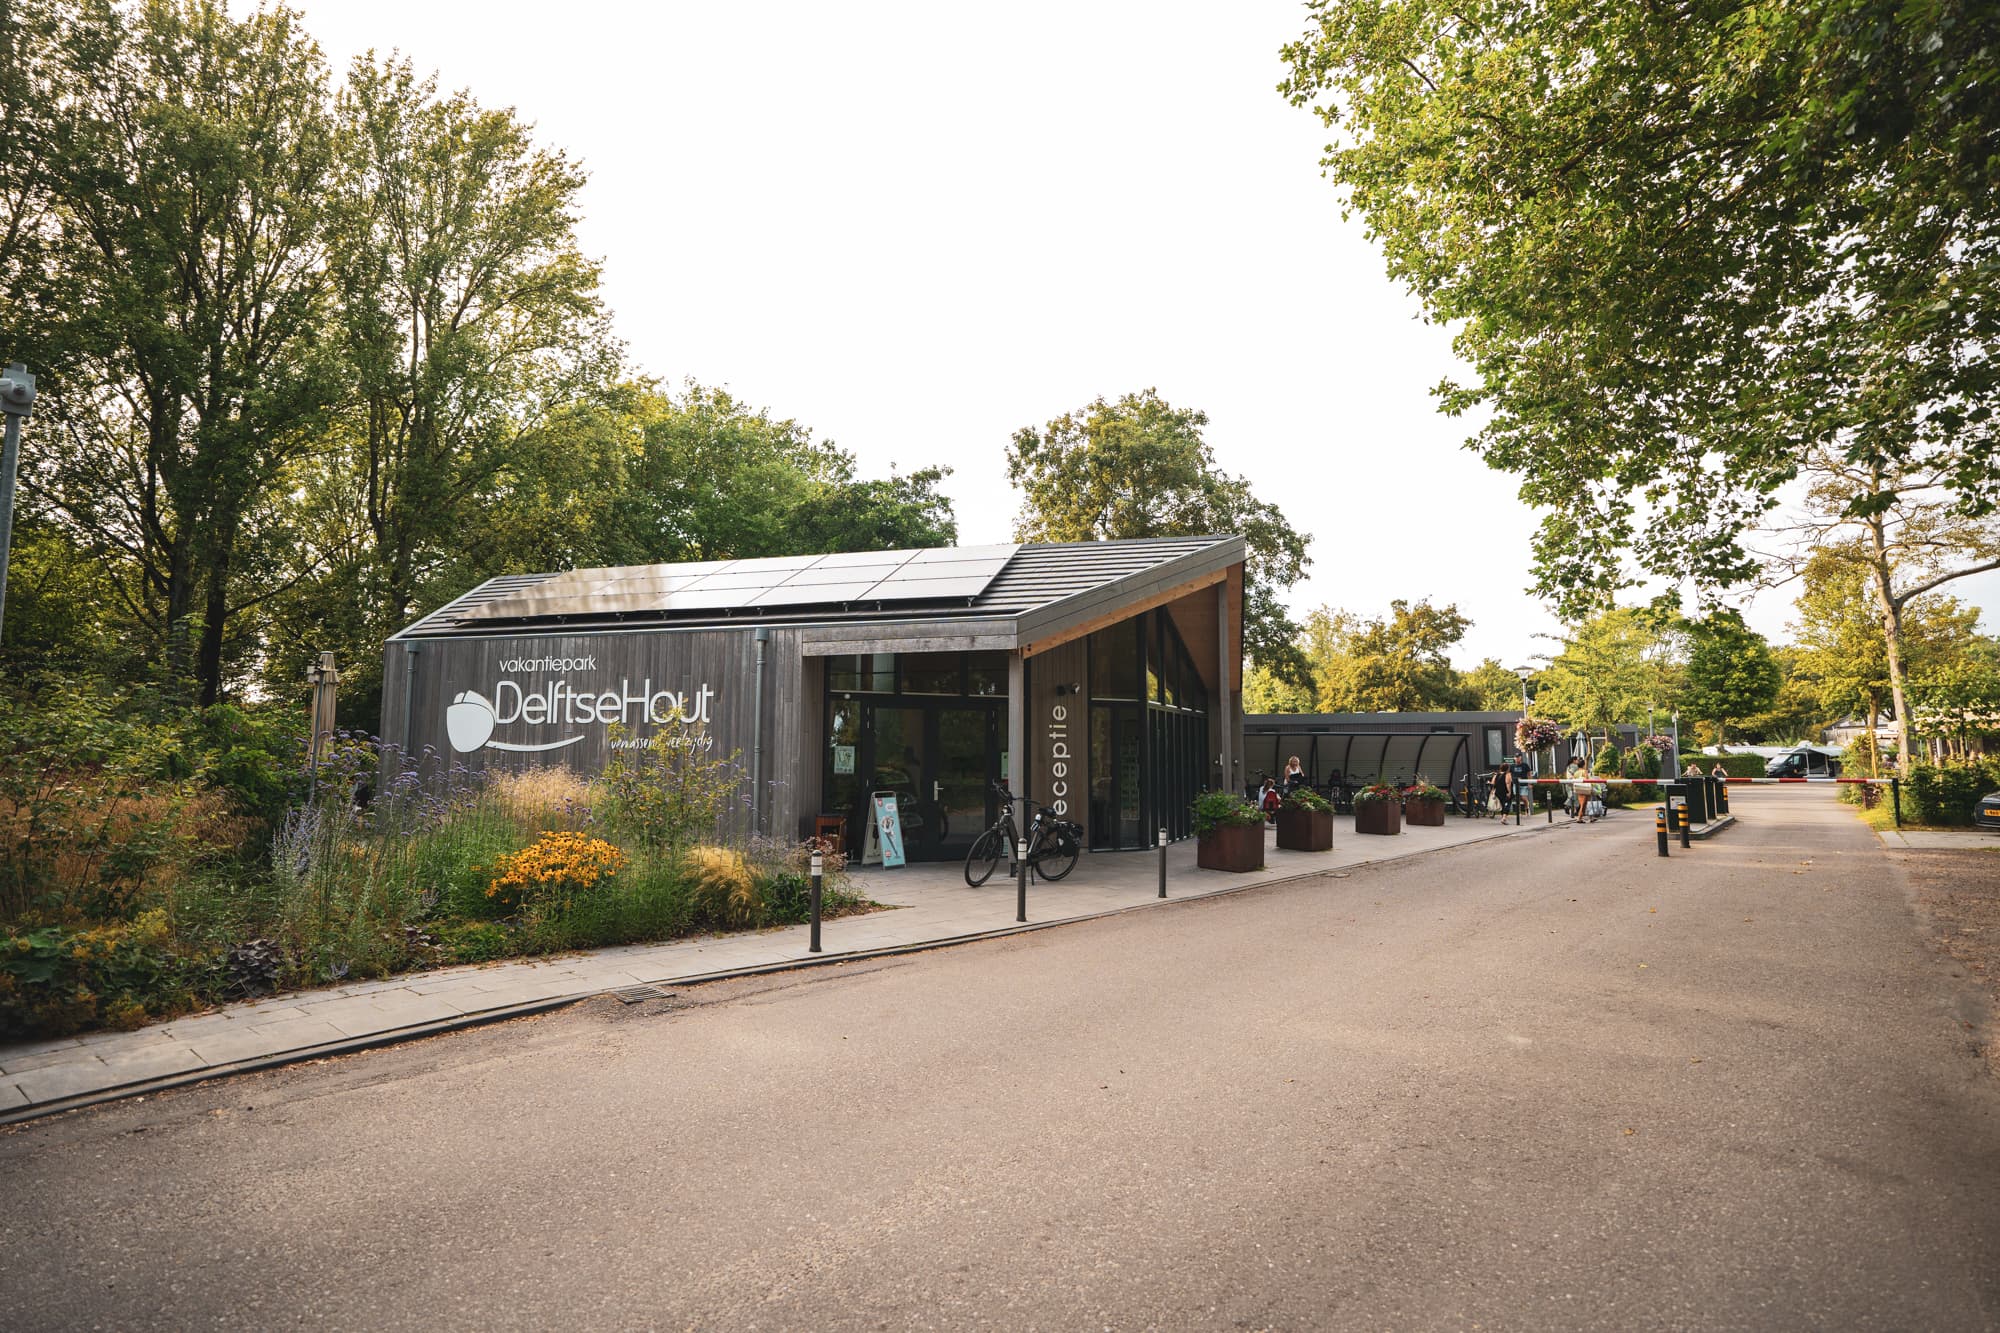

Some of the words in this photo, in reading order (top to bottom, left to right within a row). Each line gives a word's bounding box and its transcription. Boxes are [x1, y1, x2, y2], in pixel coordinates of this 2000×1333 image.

[499, 655, 597, 674] vakantiepark
[496, 678, 714, 724] DelftseHout
[1049, 705, 1071, 817] eceptie
